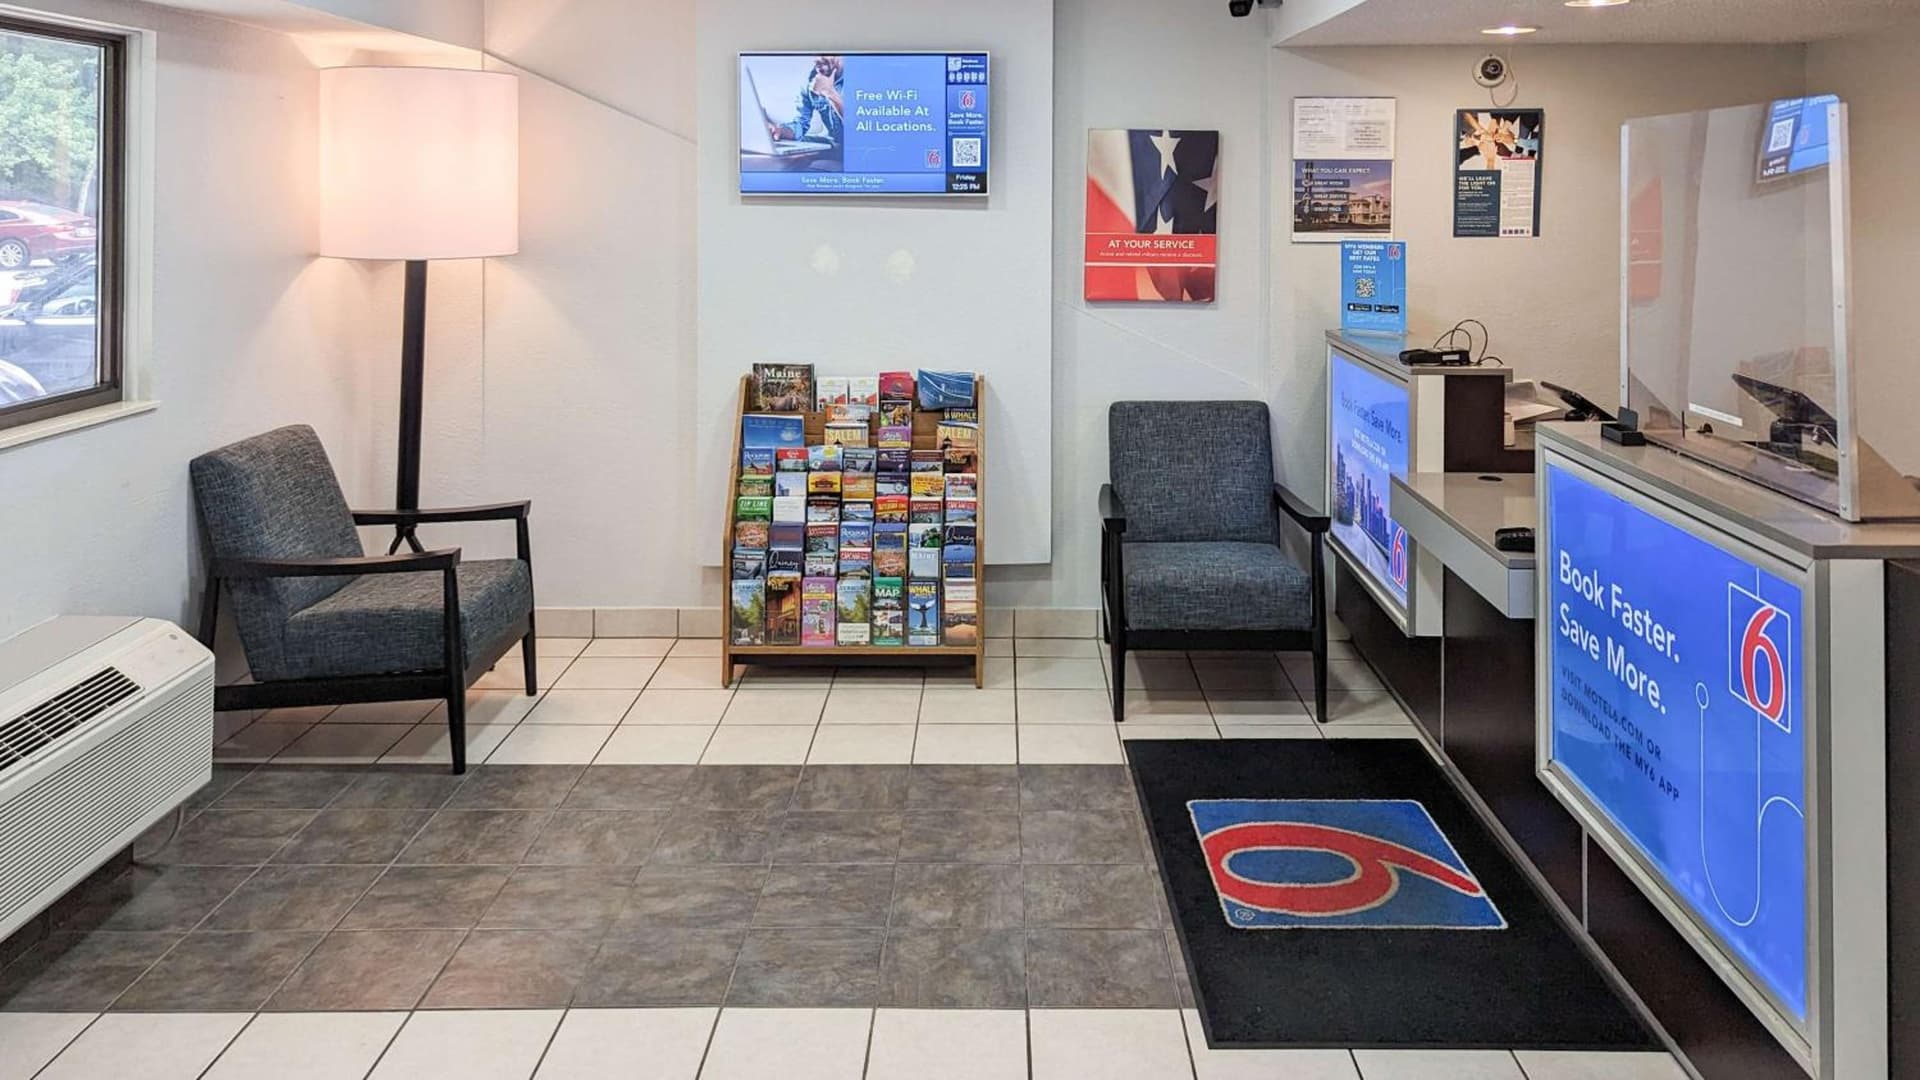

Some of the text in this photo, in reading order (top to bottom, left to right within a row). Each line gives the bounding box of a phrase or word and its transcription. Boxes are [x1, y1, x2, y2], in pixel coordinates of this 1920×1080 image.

[856, 89, 918, 101] Free Wi-Fi
[856, 105, 929, 116] Available At
[856, 121, 937, 132] All Locations.
[1108, 239, 1196, 249] AT YOUR SERVICE
[764, 368, 801, 378] Maine
[951, 411, 977, 419] WHALE
[827, 428, 859, 439] SALEM
[941, 427, 970, 440] SALEM
[875, 588, 900, 597] MAP
[909, 586, 937, 594] WHALE
[1560, 549, 1680, 663] Book Faster.
[1559, 602, 1666, 715] Save More.
[1741, 605, 1786, 723] 6
[1562, 666, 1661, 761] VISIT MOTEL6.COM OR
[1561, 688, 1680, 800] DOWNLOAD THE MY6 APP
